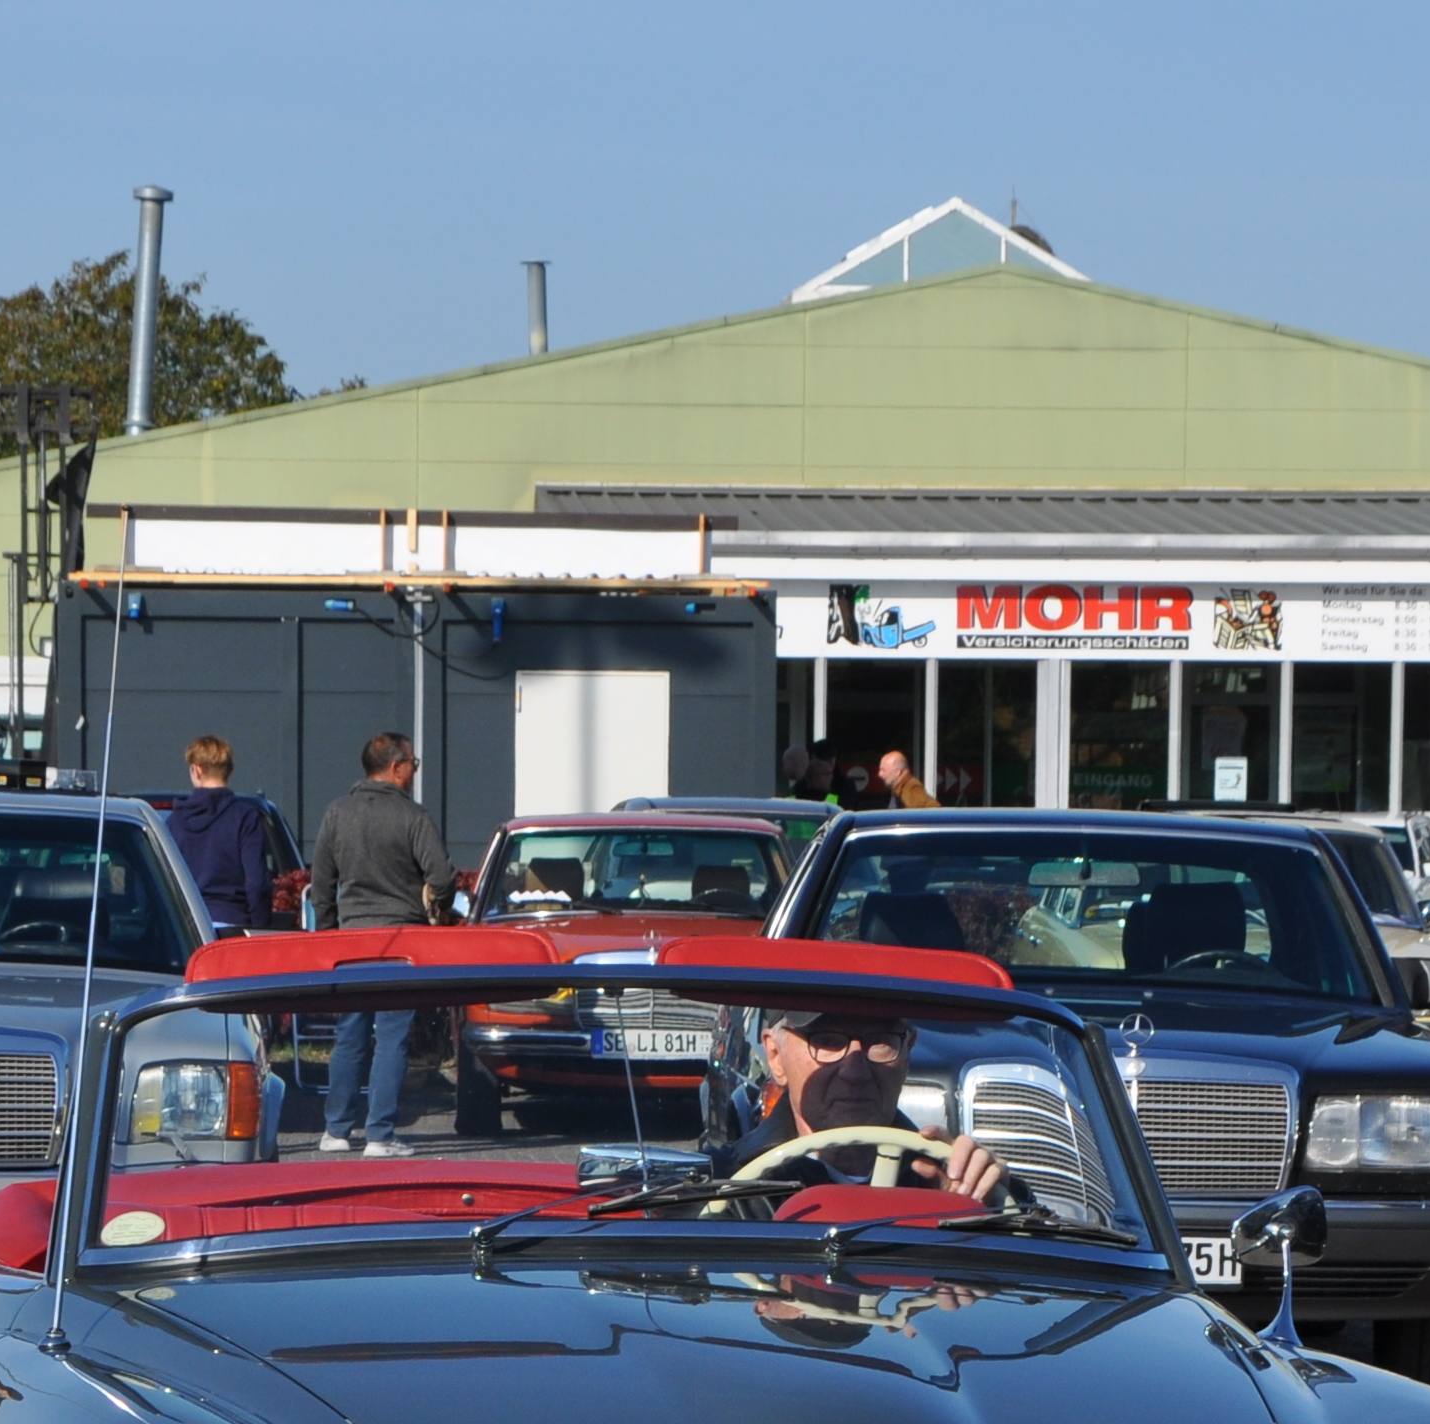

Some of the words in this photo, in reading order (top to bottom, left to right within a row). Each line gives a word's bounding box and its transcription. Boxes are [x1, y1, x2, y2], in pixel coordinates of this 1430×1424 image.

[1322, 586, 1340, 597] Wir
[1344, 586, 1368, 597] sind
[1389, 586, 1405, 597] Sie
[957, 584, 1193, 631] MOHR
[1322, 601, 1362, 611] Montag
[1322, 615, 1385, 625] Donnerstag
[1321, 629, 1359, 640] Freitag
[962, 635, 1187, 650] Versicherungsschäden
[1321, 643, 1368, 653] Samstag
[1073, 773, 1153, 788] EINGANG
[604, 1032, 624, 1052] SE
[637, 1033, 658, 1052] LI
[665, 1033, 697, 1052] 81H
